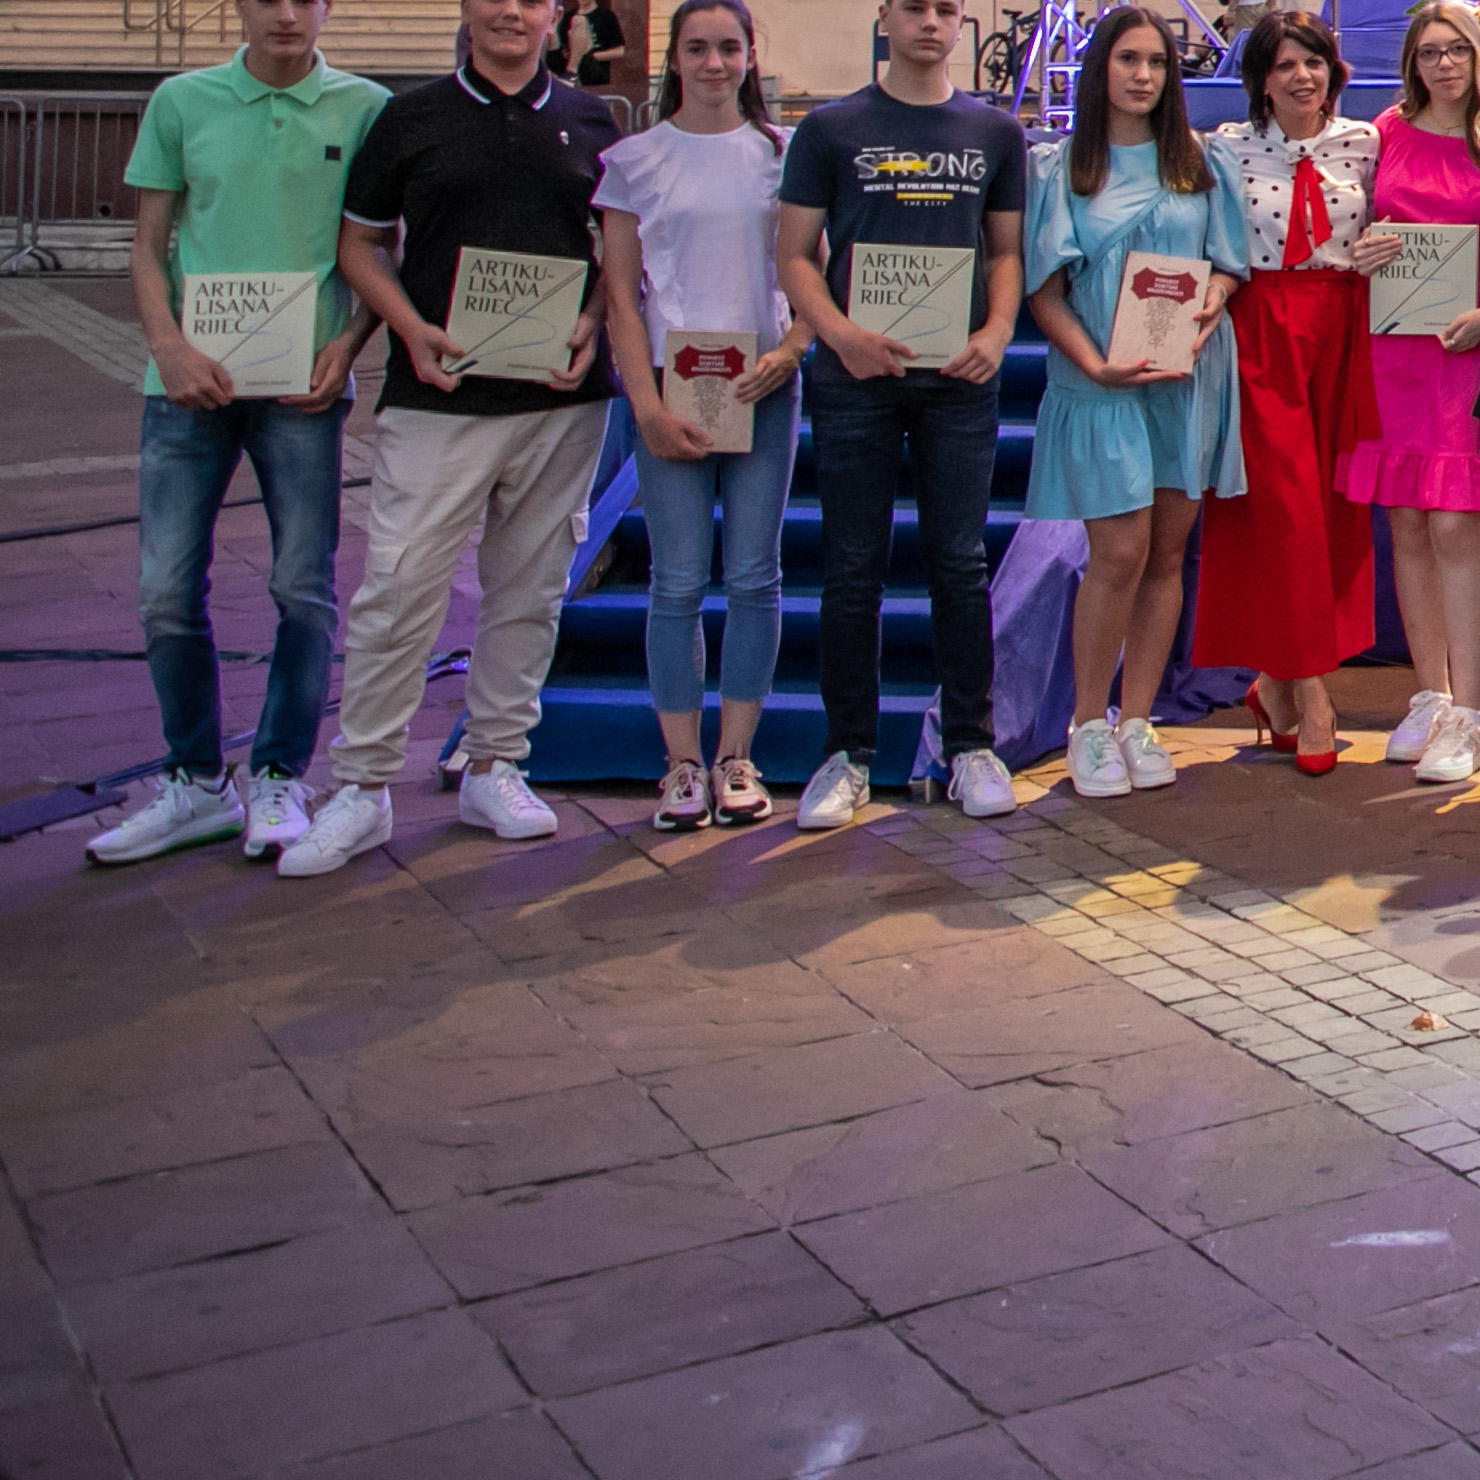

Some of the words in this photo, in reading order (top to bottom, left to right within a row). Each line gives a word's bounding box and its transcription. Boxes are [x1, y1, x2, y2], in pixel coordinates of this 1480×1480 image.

[853, 152, 987, 181] STRONG
[1382, 231, 1450, 246] TIKU-
[862, 252, 943, 270] ARTIKU-
[1396, 248, 1440, 262] SANA
[471, 259, 555, 280] ARTIKU-
[1380, 262, 1422, 279] RIJEČ
[469, 275, 539, 298] LISANA
[862, 270, 931, 288] LISANA
[196, 281, 284, 297] ARTIKU-
[861, 287, 908, 306] RIJEČ
[195, 298, 270, 315] LISANA
[465, 295, 516, 315] RIJEČ
[194, 315, 249, 334] RIJEČ
